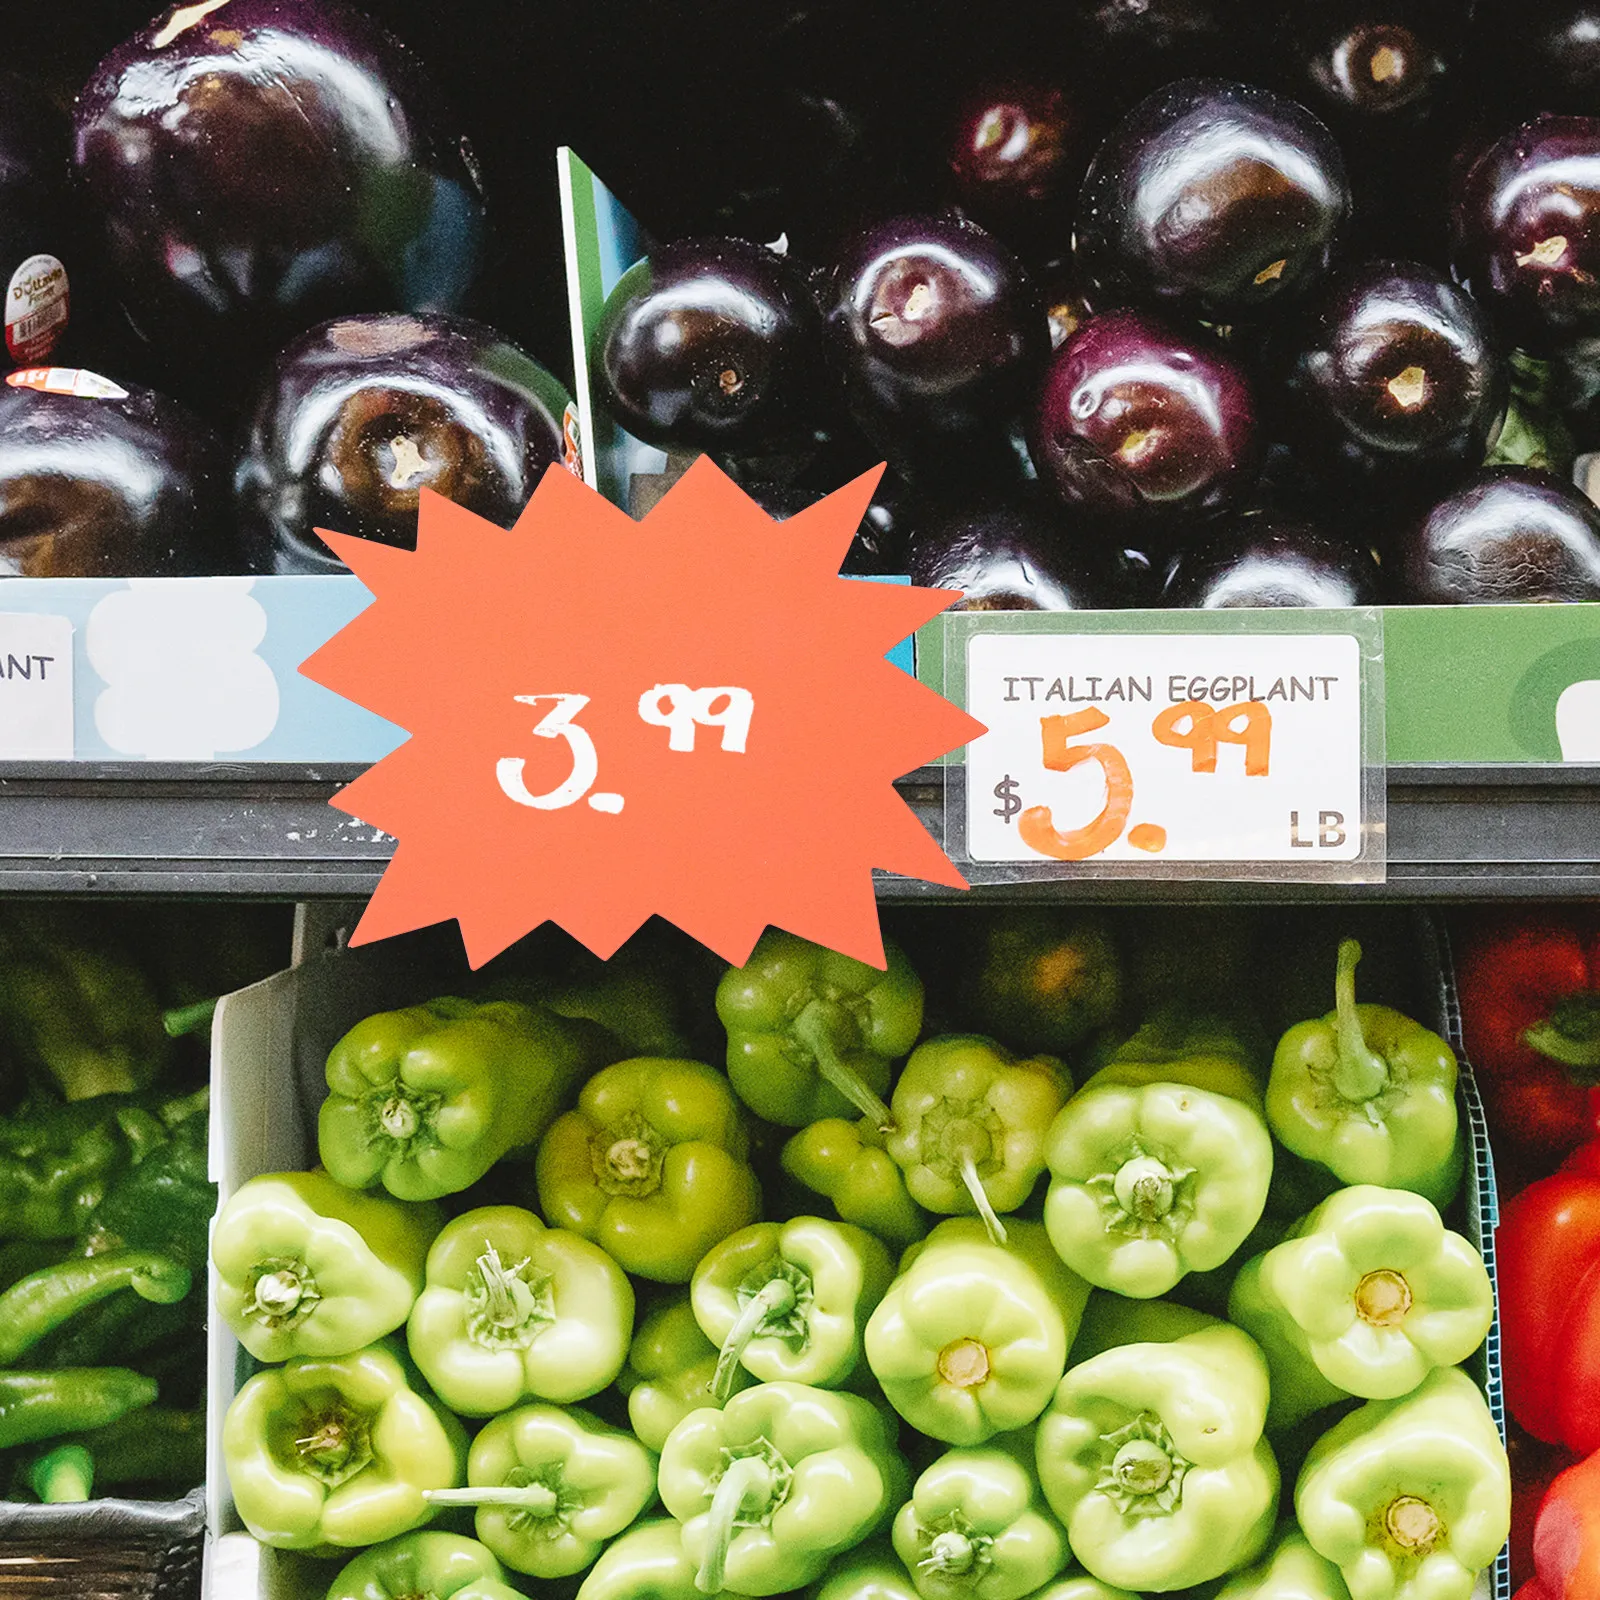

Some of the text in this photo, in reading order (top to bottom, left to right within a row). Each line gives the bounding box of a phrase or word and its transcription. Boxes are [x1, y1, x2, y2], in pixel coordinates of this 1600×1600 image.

[0, 653, 55, 680] NT
[1003, 676, 1339, 703] ITALIAN EGGPLANT
[1289, 810, 1347, 849] LB
